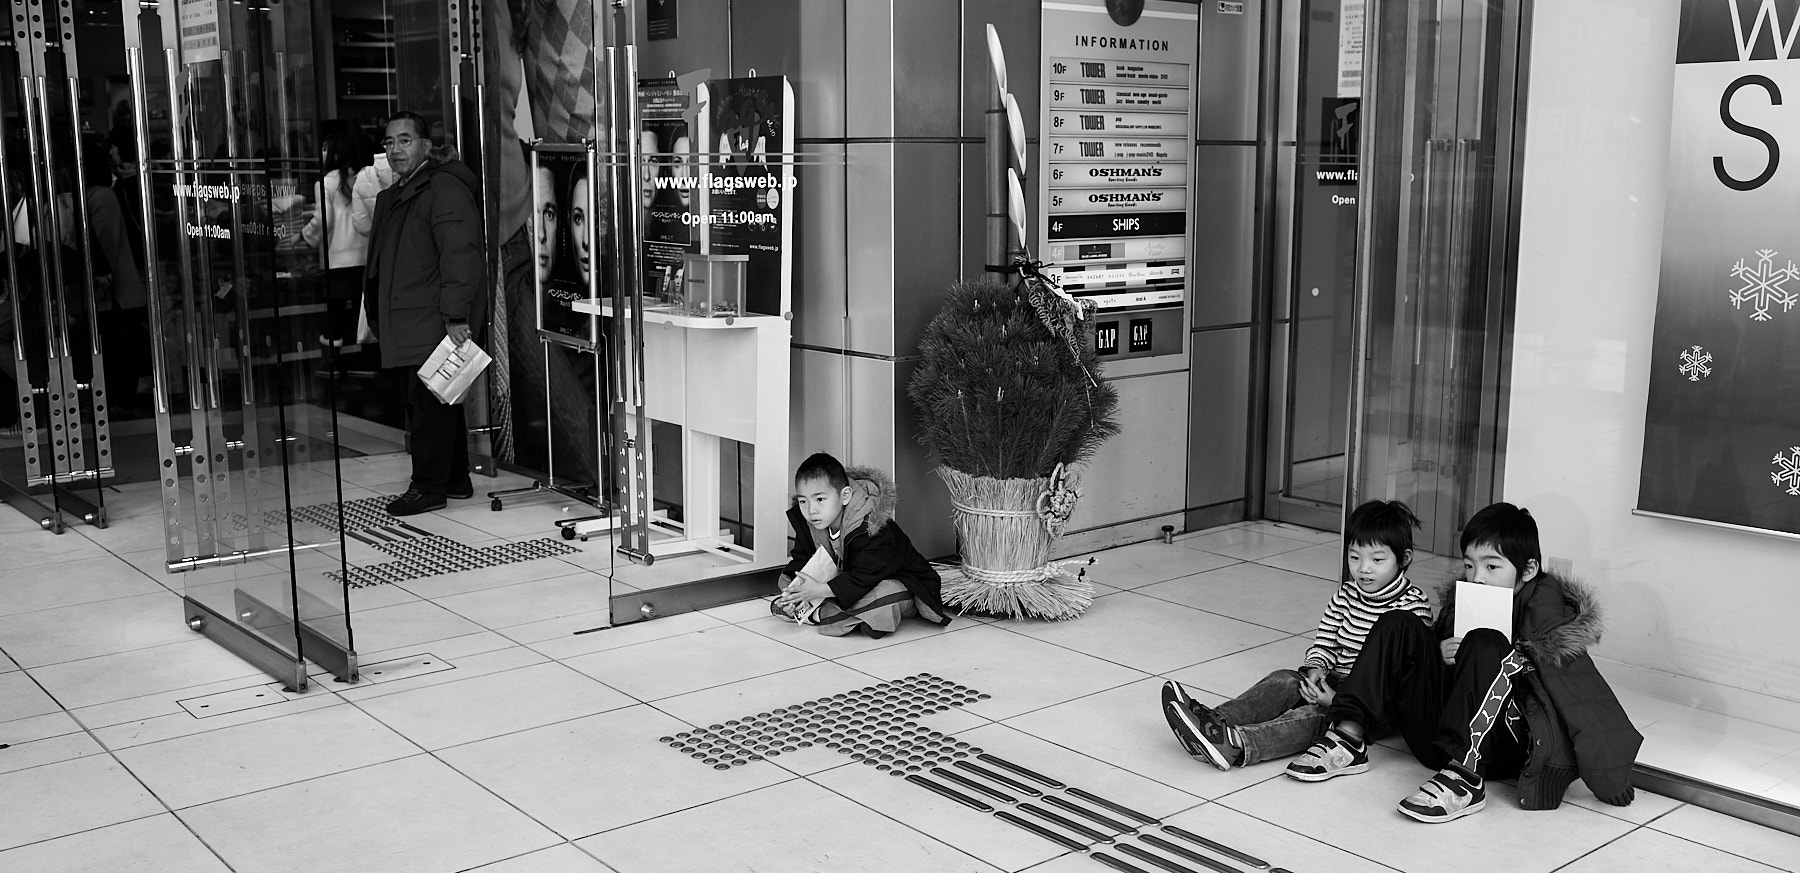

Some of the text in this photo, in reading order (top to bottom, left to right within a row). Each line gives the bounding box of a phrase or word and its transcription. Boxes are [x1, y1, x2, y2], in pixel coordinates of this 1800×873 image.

[1075, 35, 1169, 51] INFORMATION
[1053, 62, 1106, 78] 10F TOWER
[1054, 88, 1106, 105] 9F TOWER
[1053, 116, 1065, 128] 8F
[1079, 114, 1105, 131] TOWER
[1712, 74, 1783, 192] S
[1053, 141, 1105, 157] 7F TOWER
[1052, 165, 1163, 180] 6F OSHMAN'S
[654, 172, 798, 192] www.flagsweb.jp
[1052, 190, 1164, 207] 5F OSHMAN'S
[1331, 194, 1356, 205] Open
[681, 211, 717, 227] Open
[721, 210, 774, 225] 11:00am
[1052, 217, 1140, 232] 4F SHIPS
[186, 222, 231, 240] Open 11:00am
[1098, 328, 1116, 349] GAP
[1133, 324, 1148, 341] GAP
